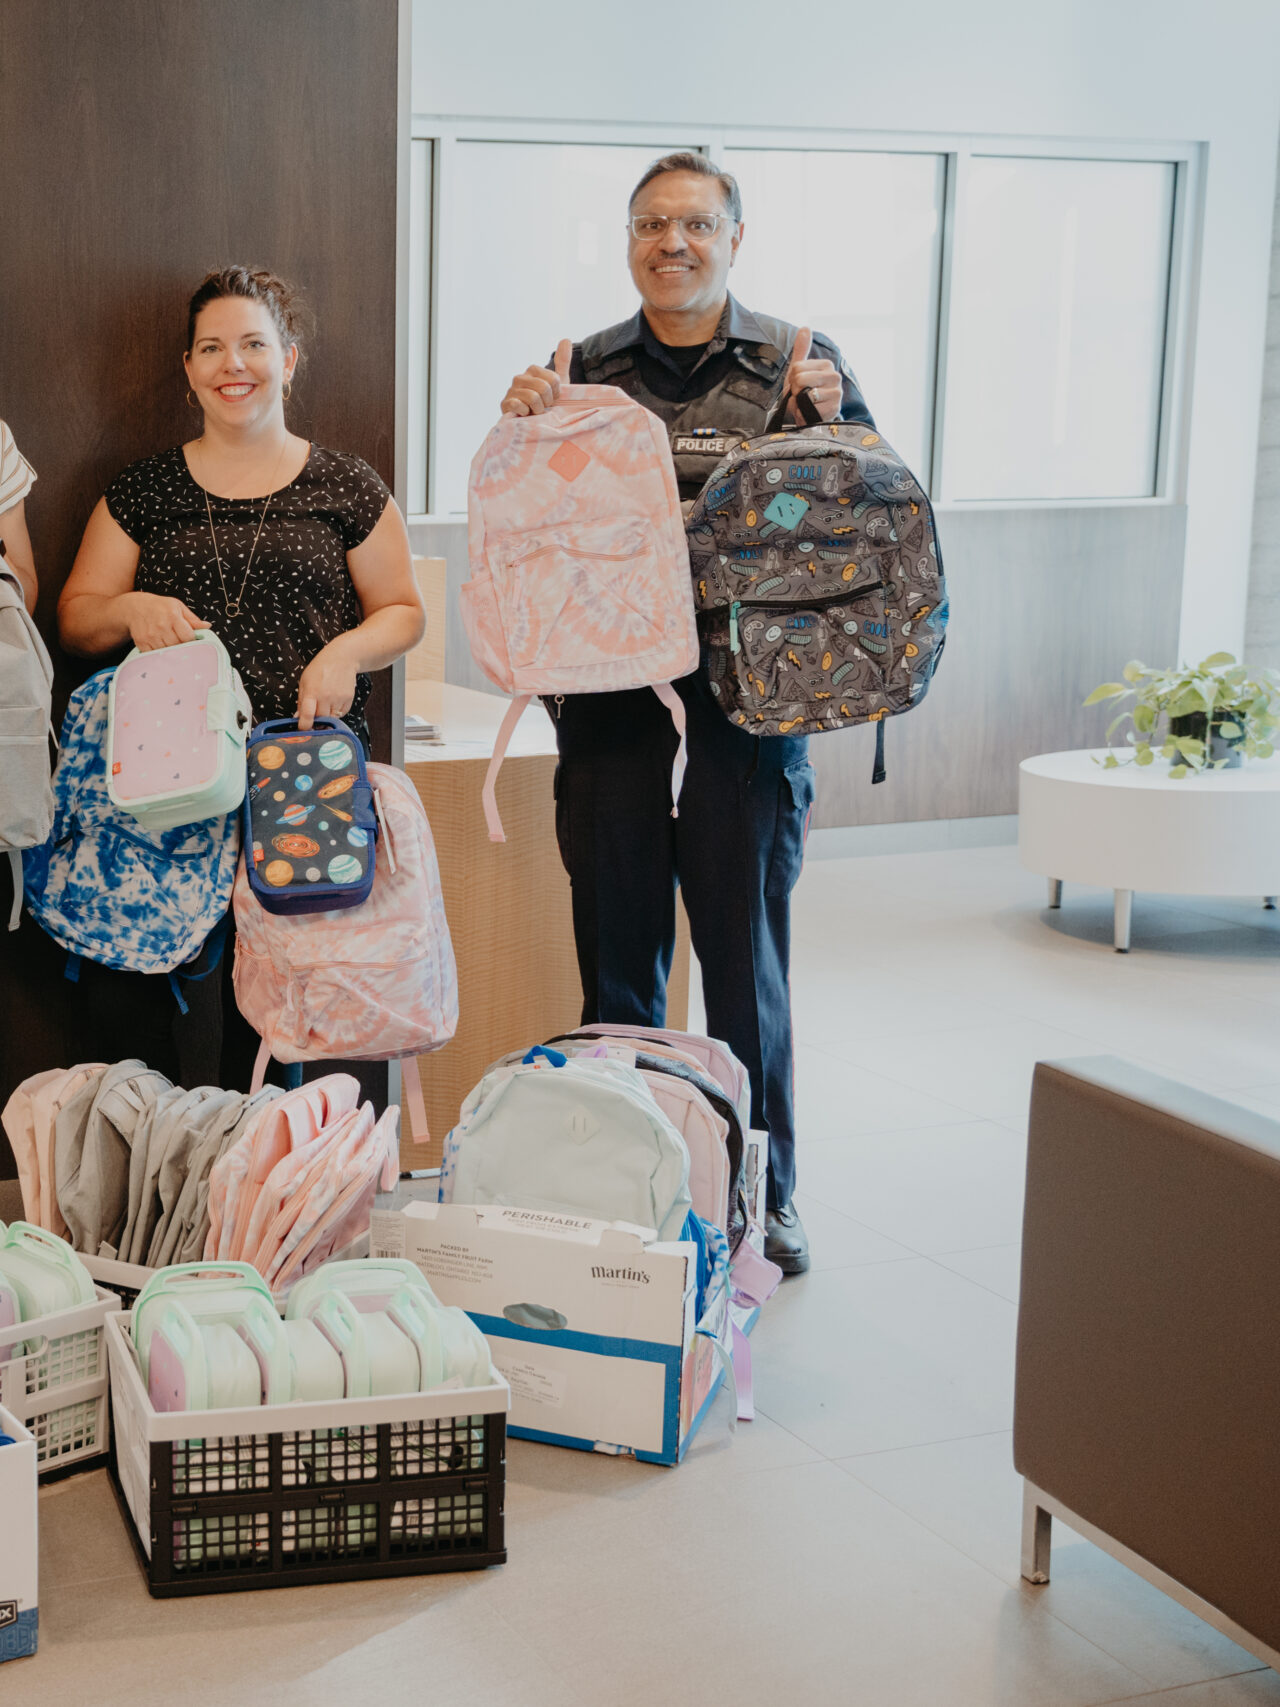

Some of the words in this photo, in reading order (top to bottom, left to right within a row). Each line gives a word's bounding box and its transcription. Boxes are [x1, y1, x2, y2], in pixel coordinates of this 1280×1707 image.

[676, 438, 725, 452] POLICE
[788, 464, 822, 480] COOL!
[502, 1210, 592, 1229] PERISHABLE
[416, 1247, 441, 1256] MARTIN'S
[442, 1251, 461, 1259] FAMILY
[440, 1244, 461, 1252] PACKED
[591, 1266, 651, 1284] martin's
